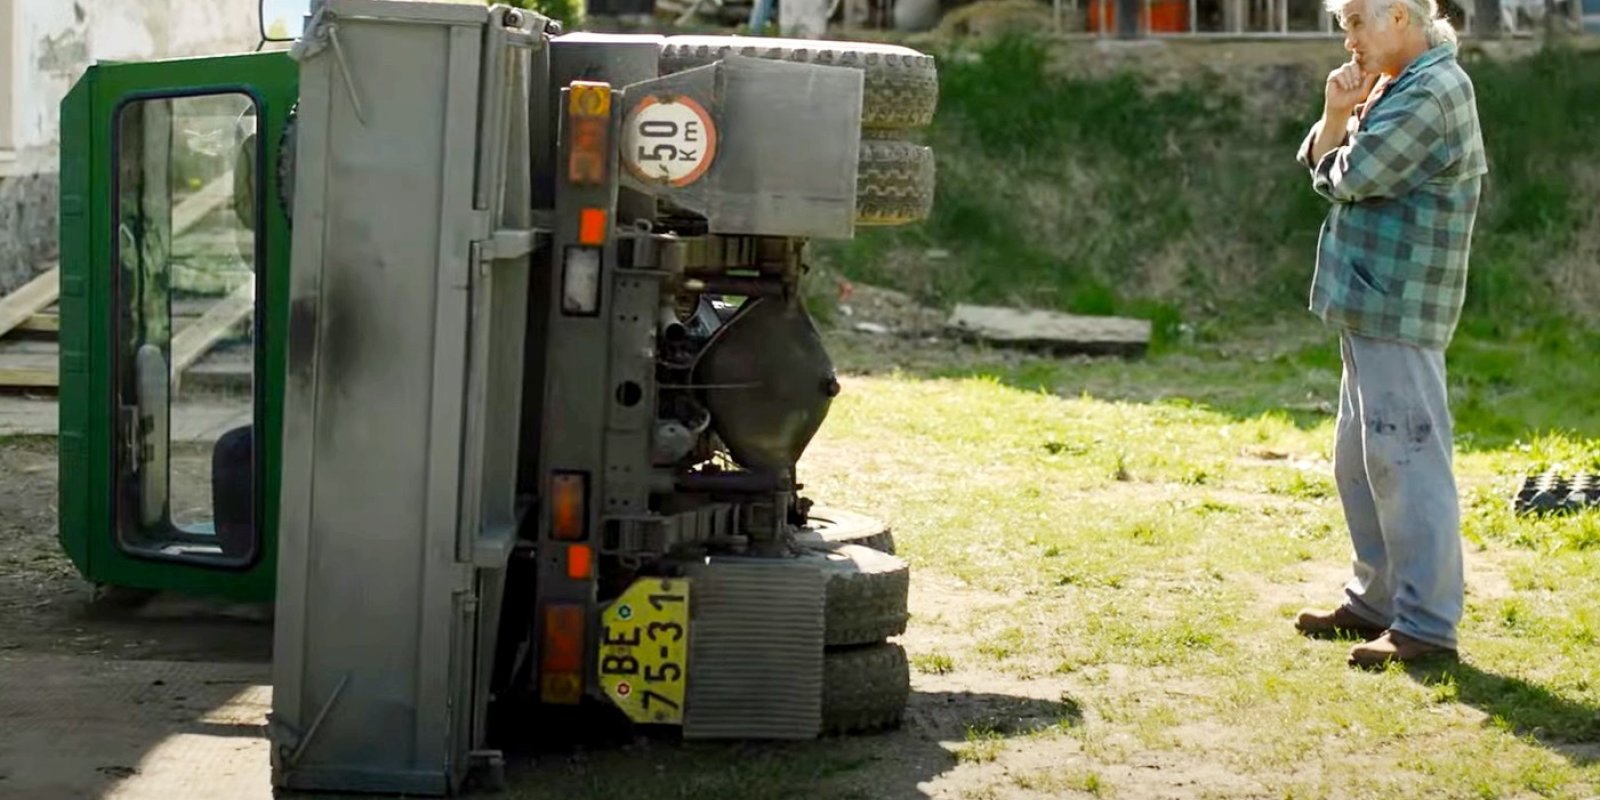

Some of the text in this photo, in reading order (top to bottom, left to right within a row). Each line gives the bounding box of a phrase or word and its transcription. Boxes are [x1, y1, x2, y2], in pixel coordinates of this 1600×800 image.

[638, 120, 678, 162] 50
[602, 626, 641, 674] BE
[641, 595, 685, 709] 75-31
